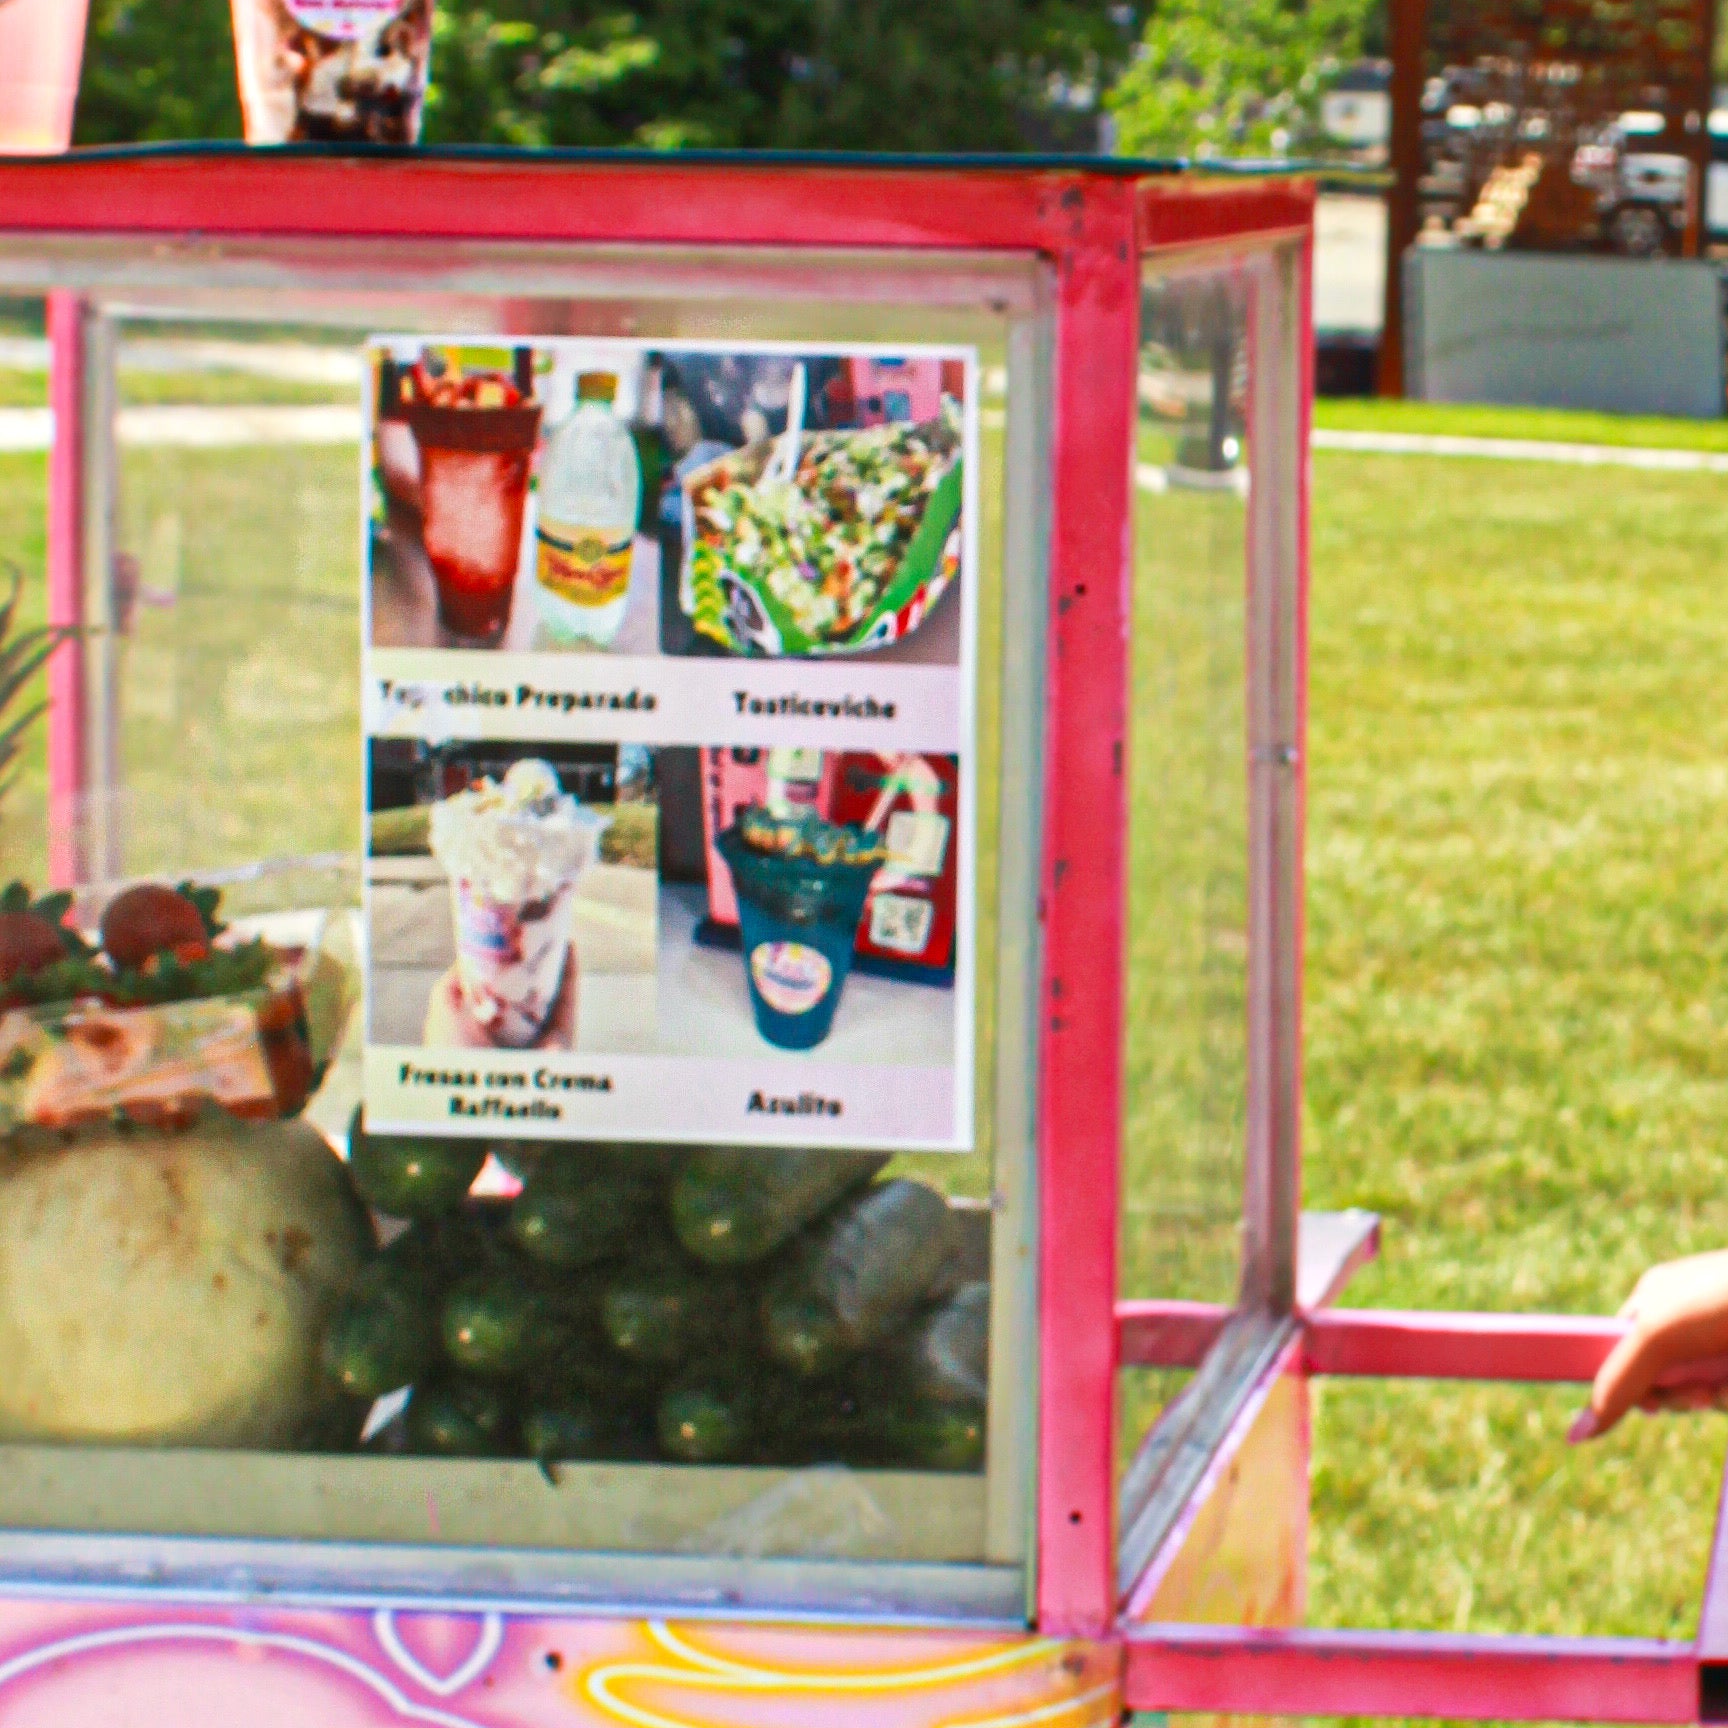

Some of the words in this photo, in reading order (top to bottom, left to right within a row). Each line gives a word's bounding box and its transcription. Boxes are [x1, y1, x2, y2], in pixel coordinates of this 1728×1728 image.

[515, 681, 657, 714] Preparado
[399, 1062, 479, 1087] Fresas
[485, 1071, 527, 1088] con
[533, 1067, 614, 1092] Crema
[746, 1089, 844, 1116] Azulito
